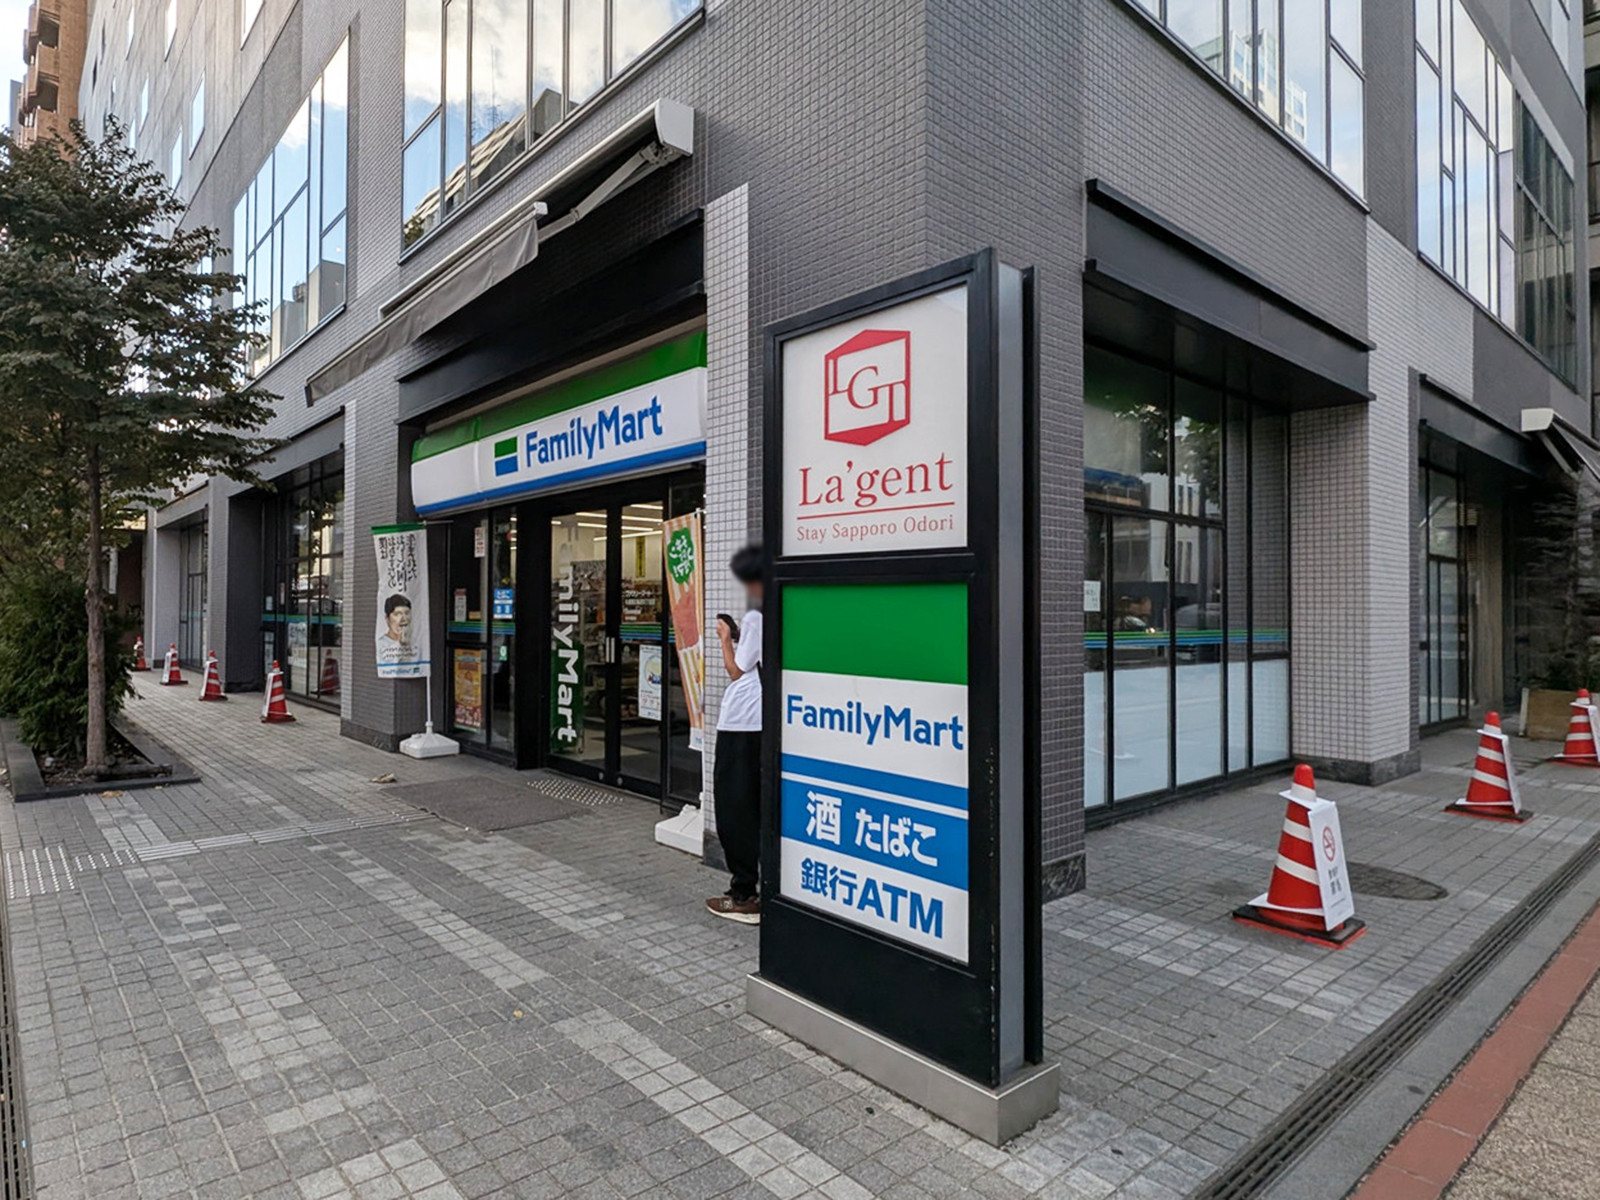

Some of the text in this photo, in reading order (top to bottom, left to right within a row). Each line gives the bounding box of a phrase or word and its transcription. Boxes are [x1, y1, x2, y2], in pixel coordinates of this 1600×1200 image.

[525, 395, 662, 468] FamilyMart
[798, 452, 953, 508] La'gent
[796, 514, 953, 544] Stay Sapporo Odori
[787, 694, 964, 750] FamilyMart
[805, 790, 938, 867] 酒 たばこ
[800, 857, 943, 939] 銀行ATM
